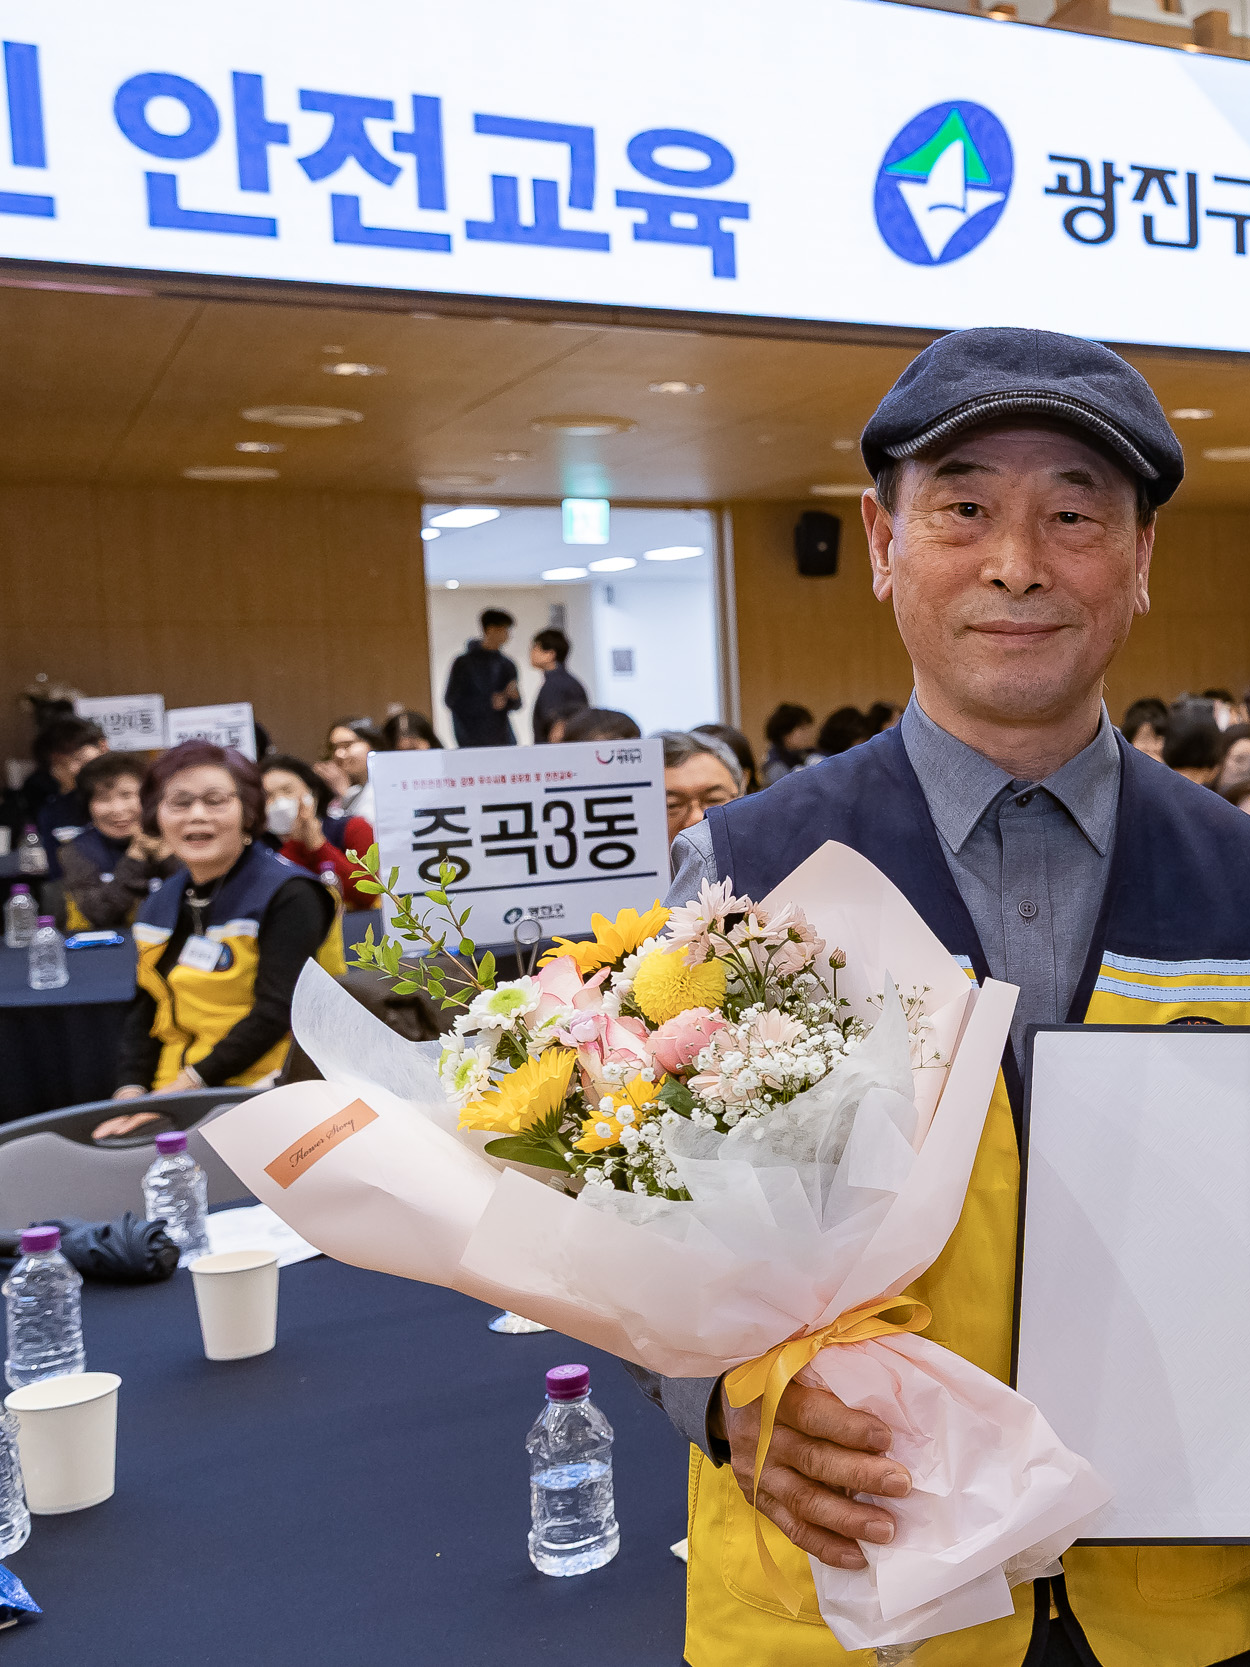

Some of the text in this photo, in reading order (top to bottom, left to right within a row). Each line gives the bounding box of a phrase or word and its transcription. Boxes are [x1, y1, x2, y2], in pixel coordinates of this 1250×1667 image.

[113, 70, 749, 279] 안전교육
[412, 795, 638, 886] 중곡3동
[289, 1118, 355, 1168] Flower Story
